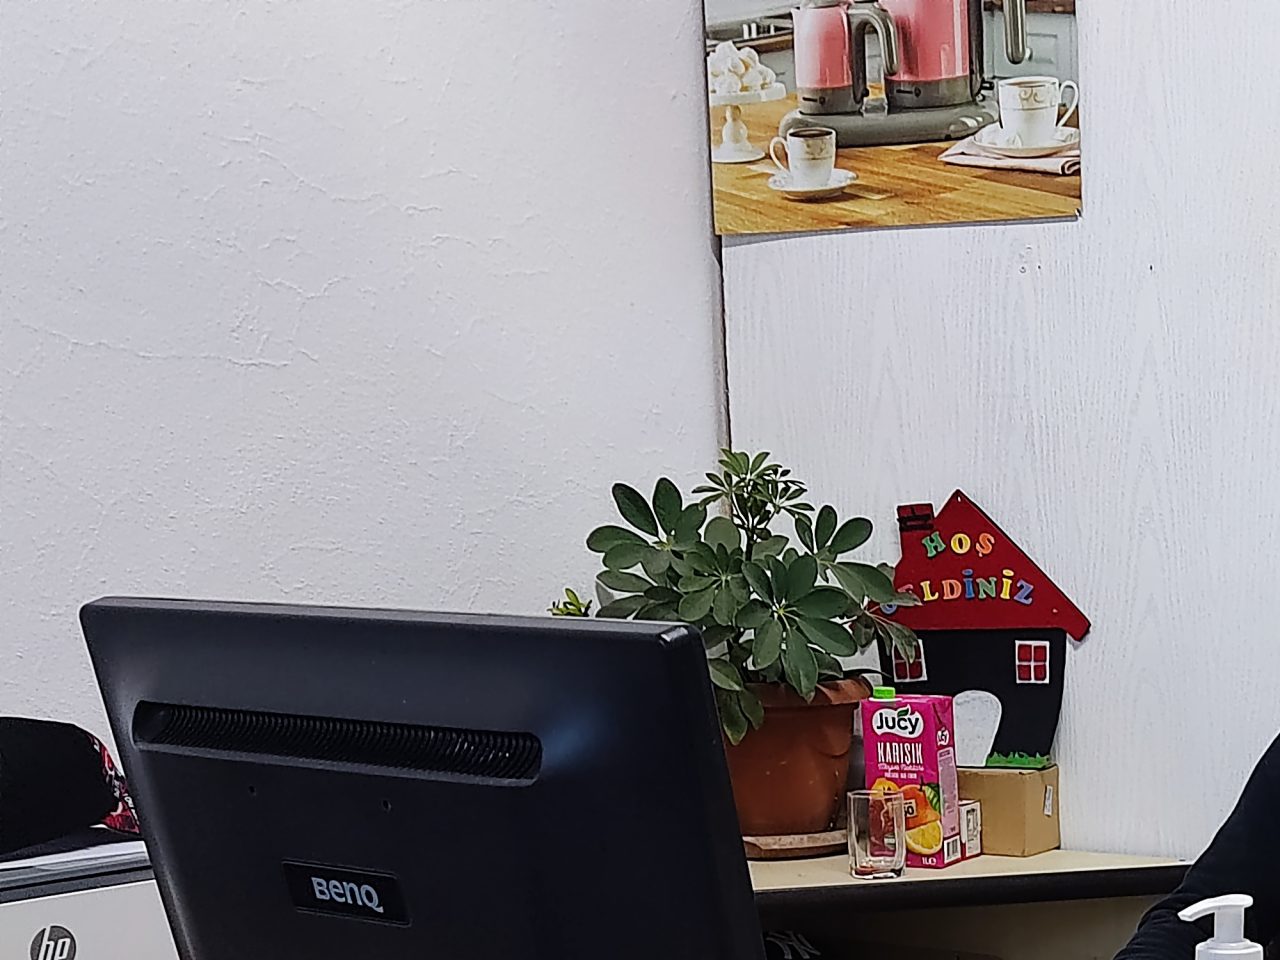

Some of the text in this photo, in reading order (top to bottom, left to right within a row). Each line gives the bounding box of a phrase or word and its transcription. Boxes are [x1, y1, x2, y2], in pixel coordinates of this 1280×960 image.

[880, 568, 1034, 614] LDİNİZ
[876, 712, 919, 735] Jucy
[311, 876, 384, 914] BenQ
